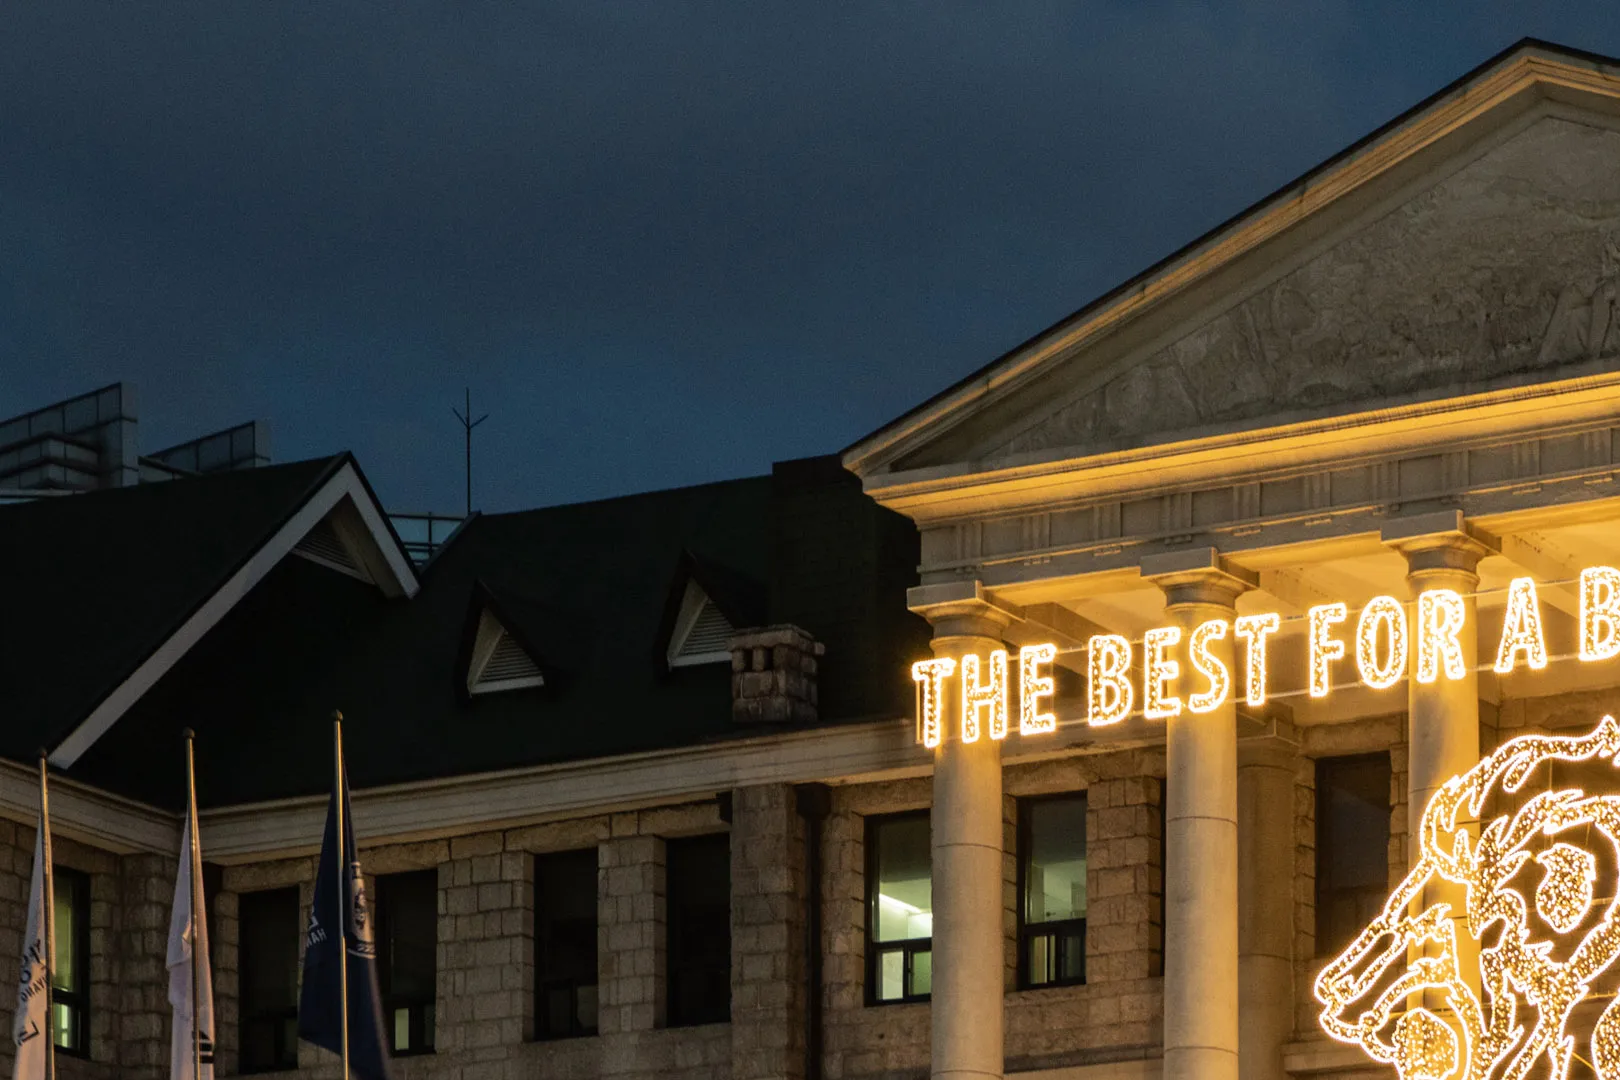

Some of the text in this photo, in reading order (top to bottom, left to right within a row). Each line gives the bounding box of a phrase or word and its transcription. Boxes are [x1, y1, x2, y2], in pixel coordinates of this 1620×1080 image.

[911, 641, 1057, 749] THE
[1086, 611, 1280, 727] BEST
[1307, 588, 1467, 699] FOR
[1493, 575, 1549, 674] A
